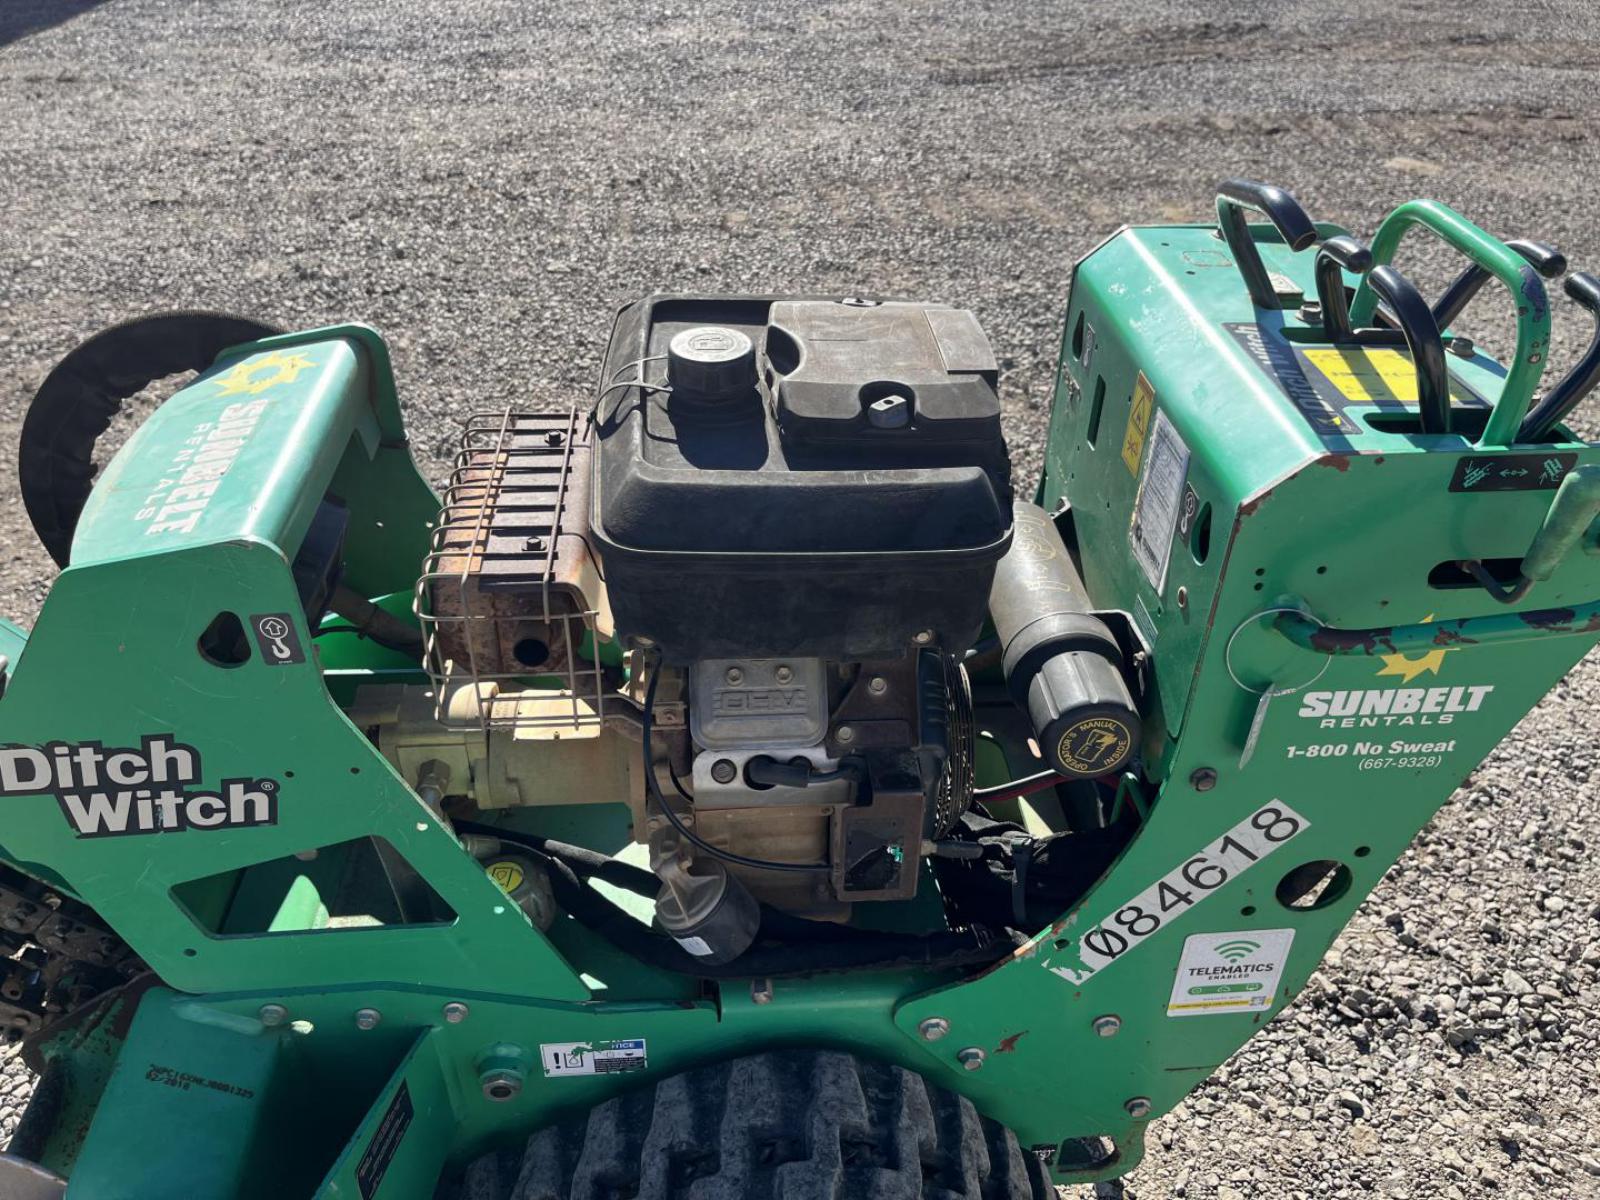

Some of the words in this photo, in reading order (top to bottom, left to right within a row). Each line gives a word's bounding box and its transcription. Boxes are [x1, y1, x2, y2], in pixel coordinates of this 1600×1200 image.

[134, 422, 213, 520] RENTALS
[145, 399, 269, 535] SUNBELT
[1299, 685, 1494, 717] SUNBELT
[1320, 714, 1454, 728] RENTALS
[1080, 721, 1117, 731] MANUAL
[1103, 740, 1127, 765] INSIDE
[1287, 744, 1348, 758] 1-800
[1353, 742, 1383, 756] No
[1388, 740, 1456, 754] Sweat
[0, 740, 193, 791] Ditch
[1359, 755, 1442, 770] (667-9328)
[1188, 963, 1274, 976] TELEMATICS
